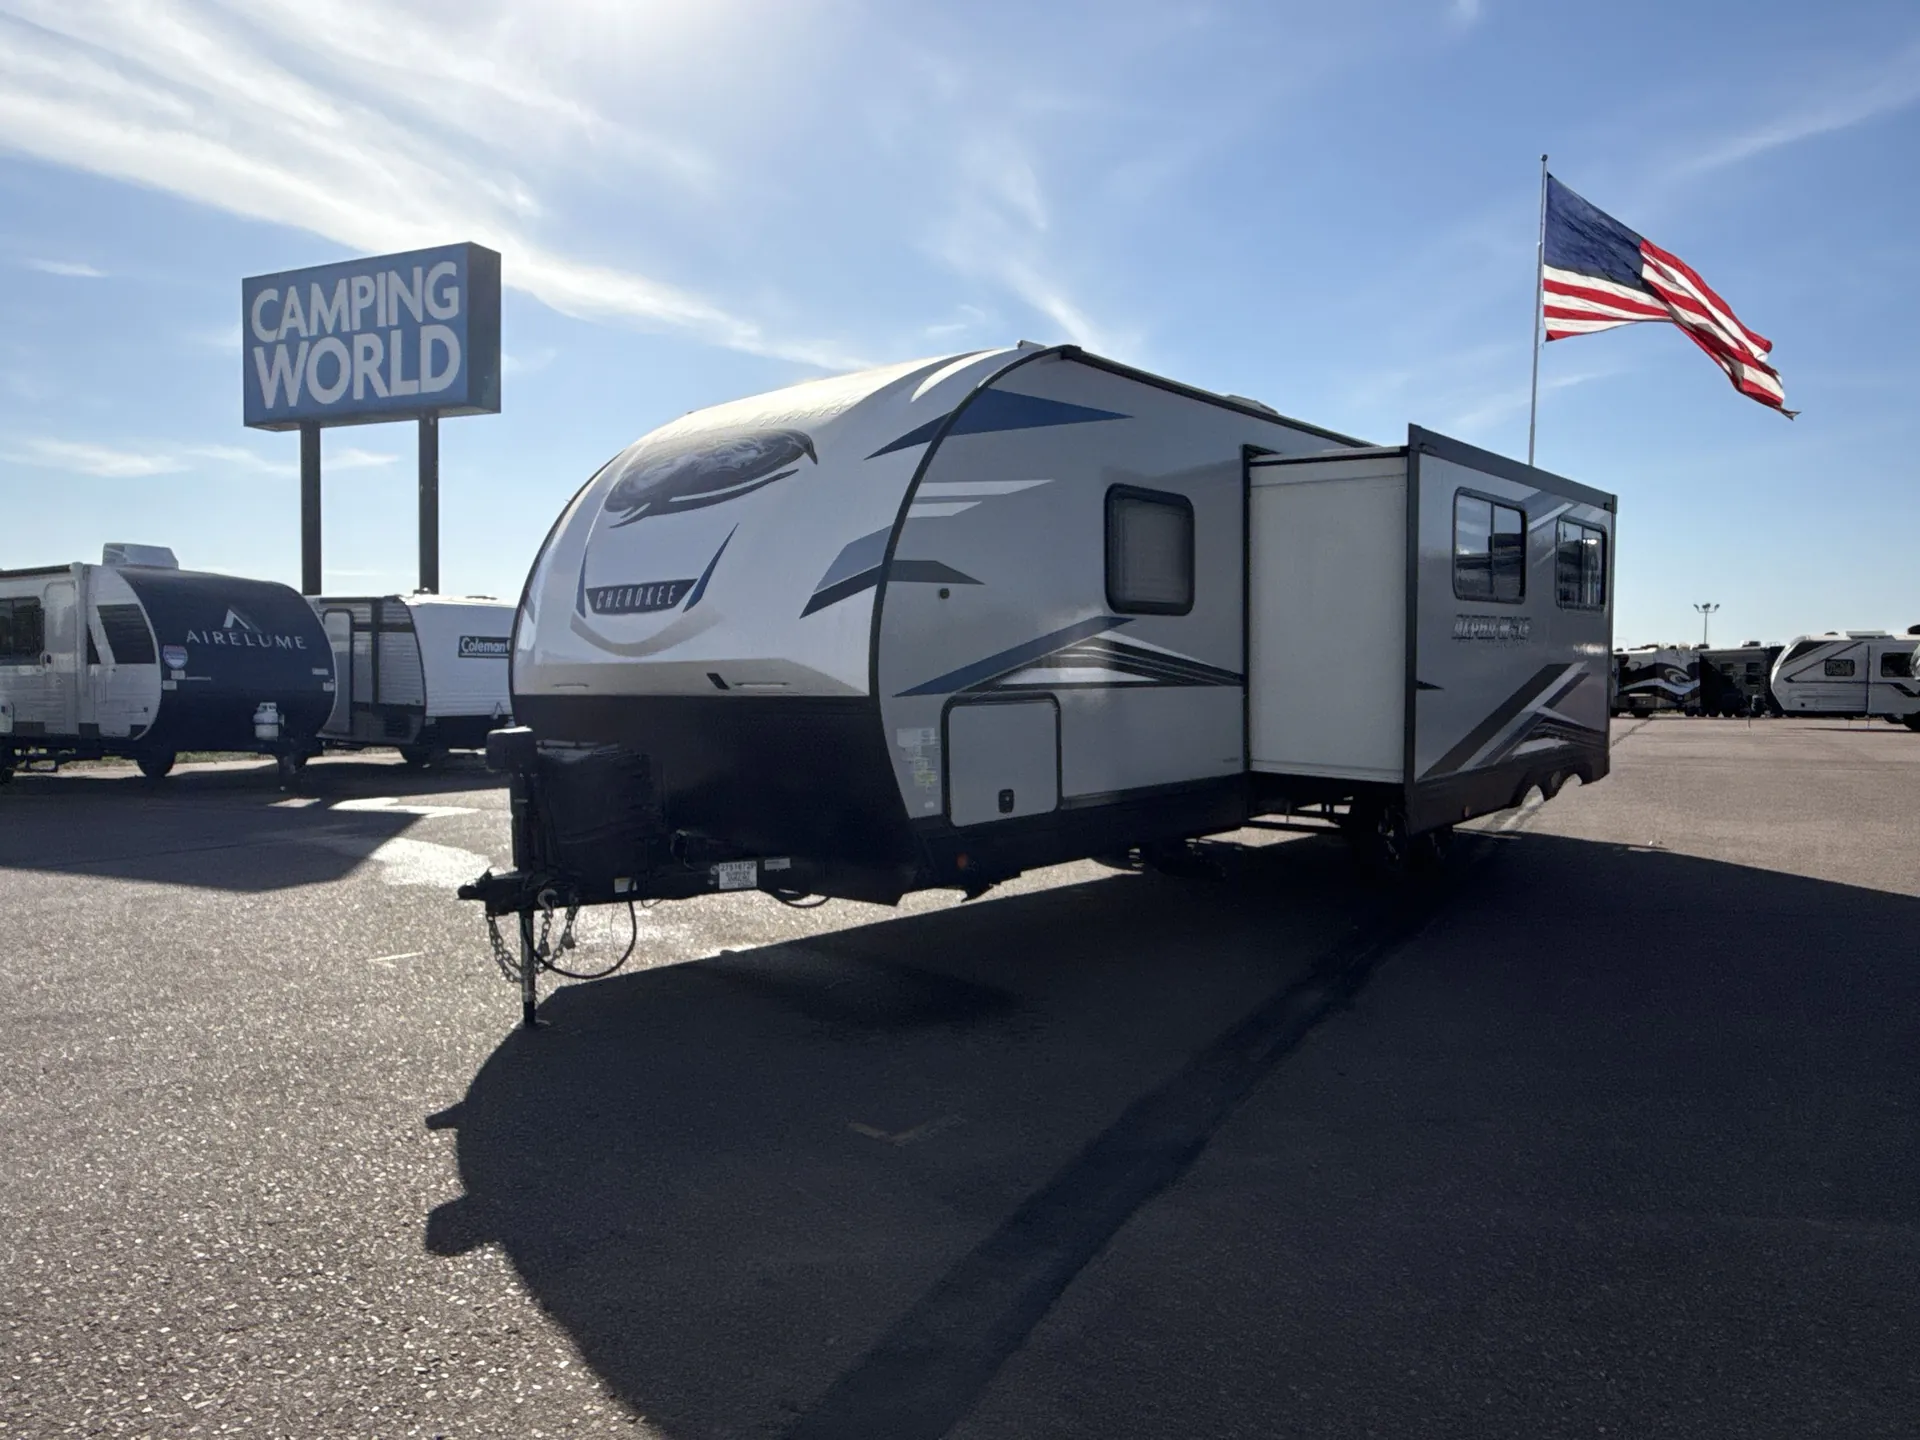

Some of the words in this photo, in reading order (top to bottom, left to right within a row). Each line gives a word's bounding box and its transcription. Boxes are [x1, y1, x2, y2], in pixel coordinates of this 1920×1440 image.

[251, 261, 459, 343] CAMPING
[253, 324, 461, 410] WORLD
[595, 584, 676, 610] CHEROKEE
[186, 629, 307, 650] AIRELUME
[460, 637, 506, 653] Coleman
